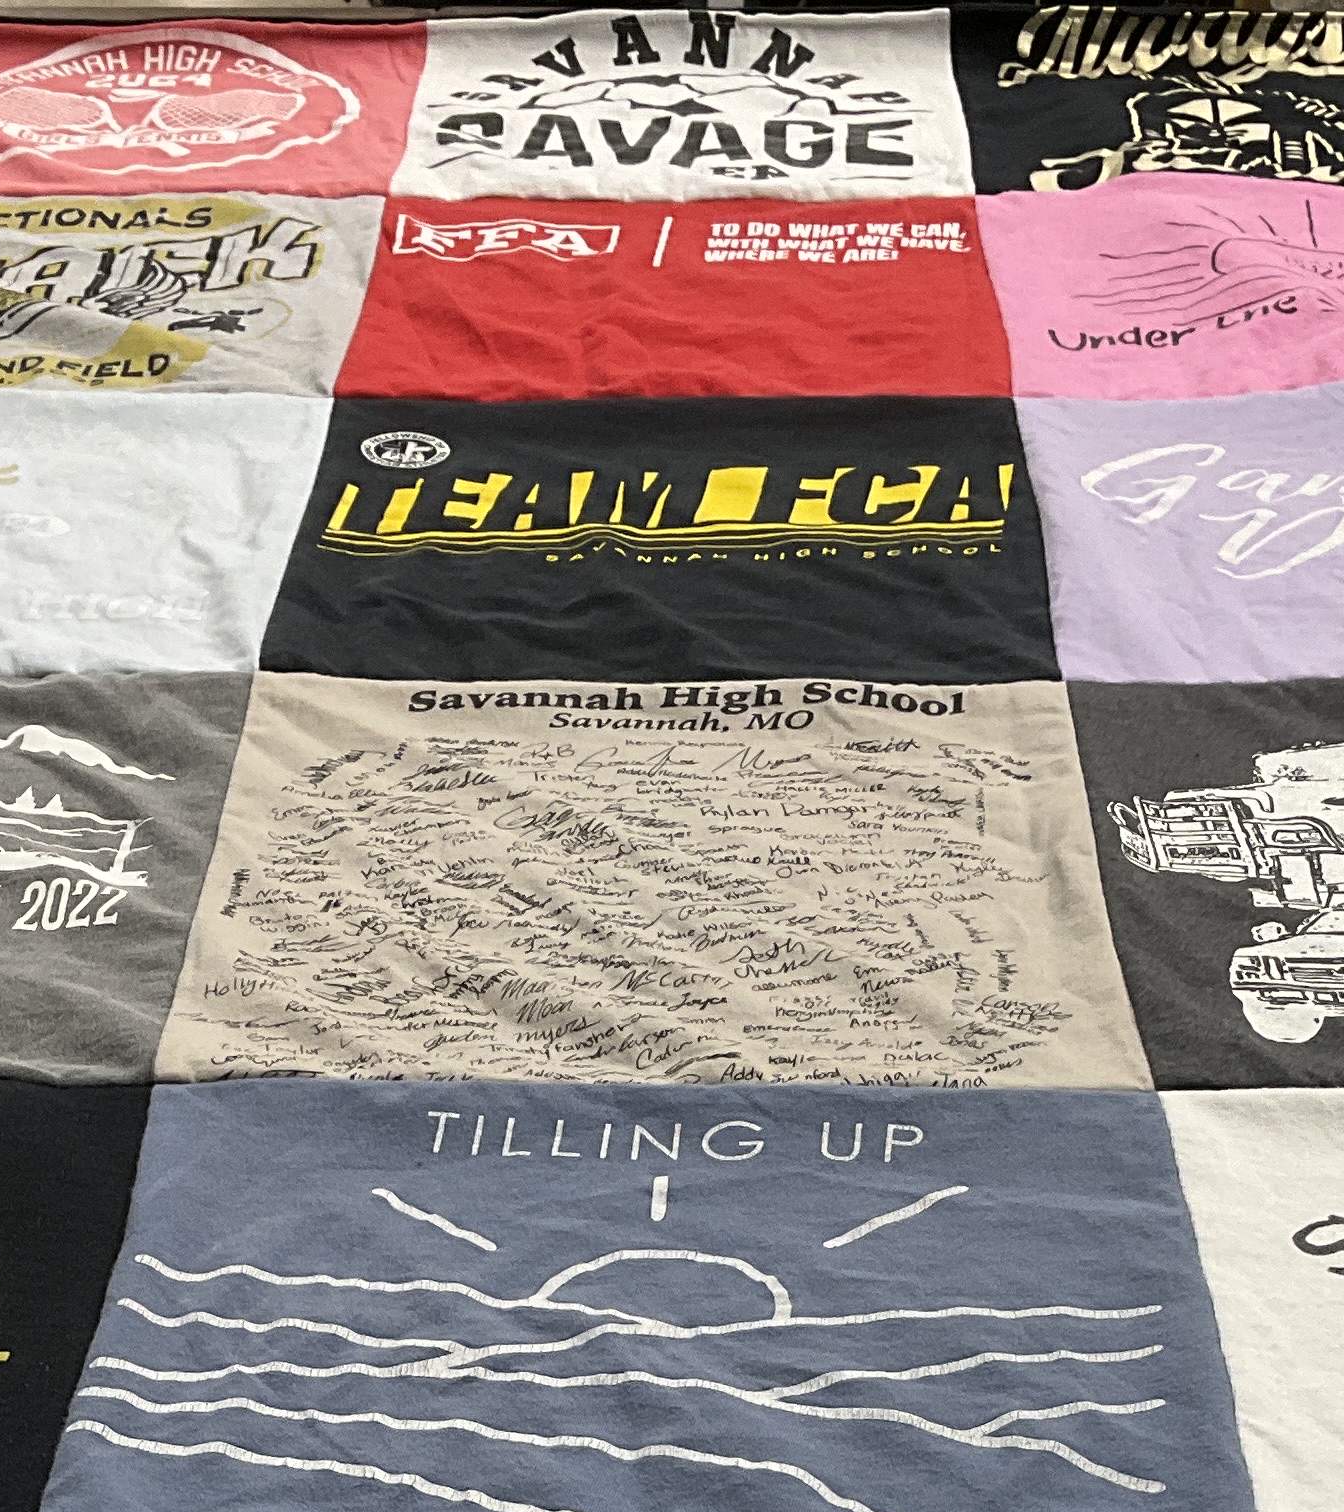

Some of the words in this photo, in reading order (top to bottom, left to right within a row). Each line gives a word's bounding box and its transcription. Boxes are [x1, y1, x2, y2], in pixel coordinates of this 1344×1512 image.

[143, 44, 222, 73] HIGH
[435, 111, 915, 169] SAVAGE
[412, 224, 605, 257] FFA
[707, 237, 769, 248] WITH
[777, 237, 850, 250] WHAT
[855, 235, 894, 248] WE
[710, 222, 741, 237] TO
[747, 222, 781, 237] DO
[788, 223, 860, 238] WHAT
[866, 222, 904, 237] WE
[704, 250, 790, 262] WHERE
[797, 250, 836, 264] WE
[1047, 321, 1197, 352] Under
[55, 353, 171, 380] FIELD
[754, 546, 838, 561] HIGH
[862, 543, 1002, 560] SCHOOL
[408, 687, 645, 713] Savannah
[659, 683, 783, 715] High
[802, 682, 966, 717] School
[744, 710, 815, 731] MO
[12, 875, 130, 932] 2022
[425, 1108, 765, 1162] TILLING
[819, 1120, 929, 1164] UP
